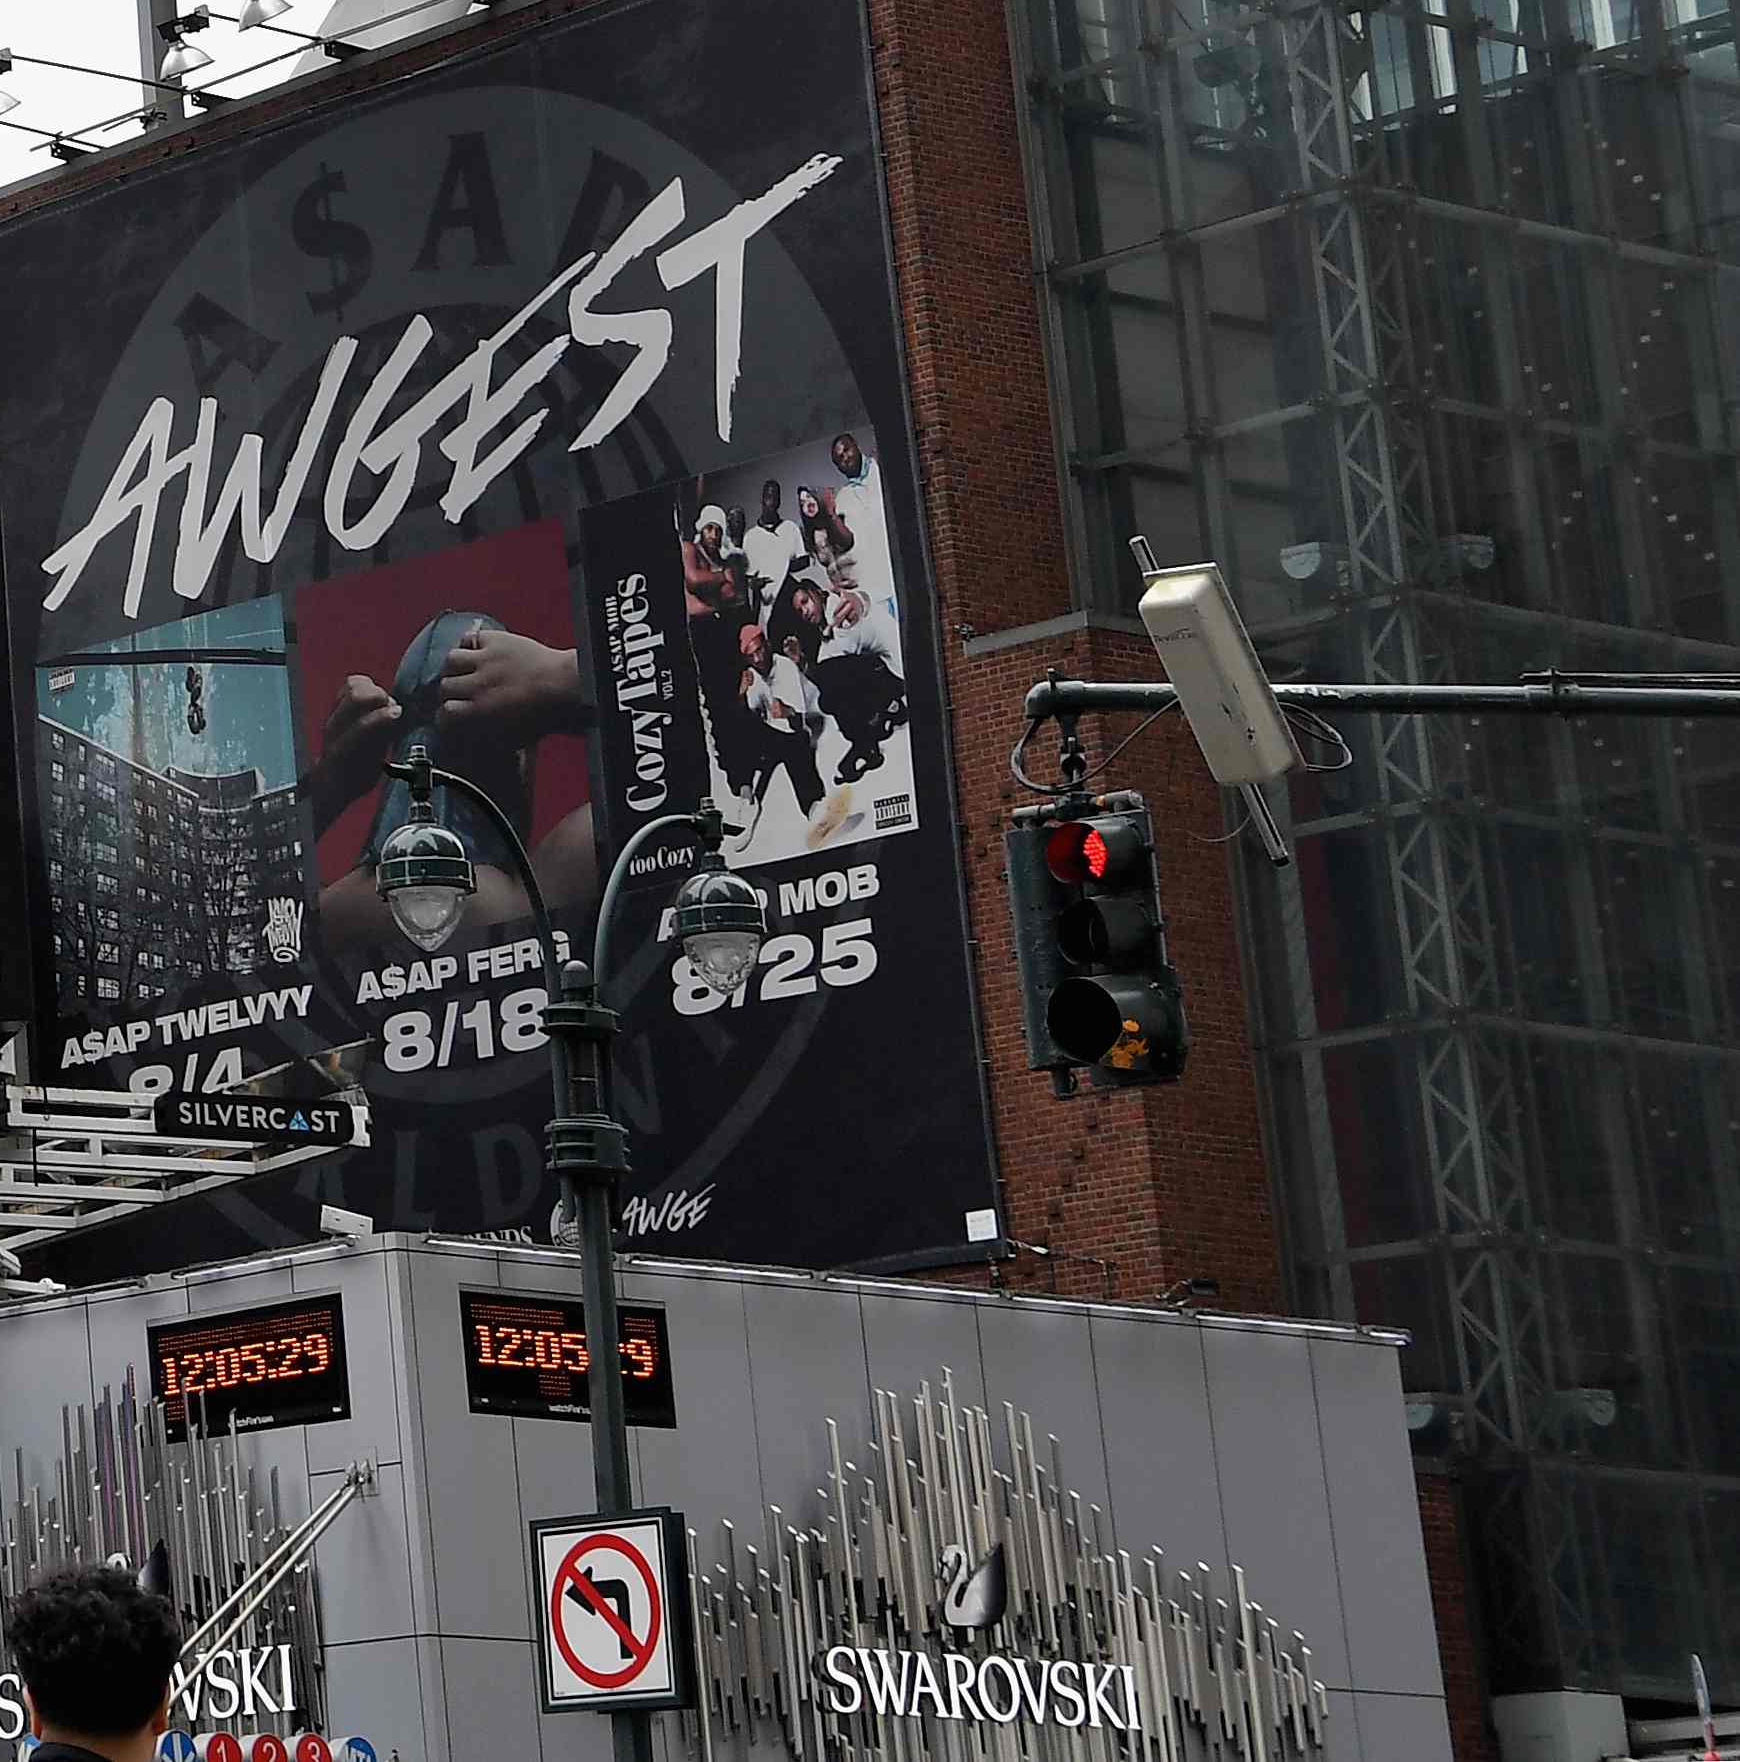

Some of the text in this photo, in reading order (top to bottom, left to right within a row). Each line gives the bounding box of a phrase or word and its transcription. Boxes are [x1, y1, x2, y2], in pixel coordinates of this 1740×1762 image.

[42, 151, 844, 619] AWGEST
[615, 572, 673, 813] Cozy Tapes
[779, 864, 880, 917] MOB
[356, 957, 458, 1005] A$AP
[61, 985, 313, 1069] A$AP TWELVYY
[383, 988, 551, 1072] 8/18
[622, 1183, 716, 1237] AWGE
[161, 1334, 328, 1396] 12:05:29
[823, 1646, 1141, 1730] SWAROVSKI
